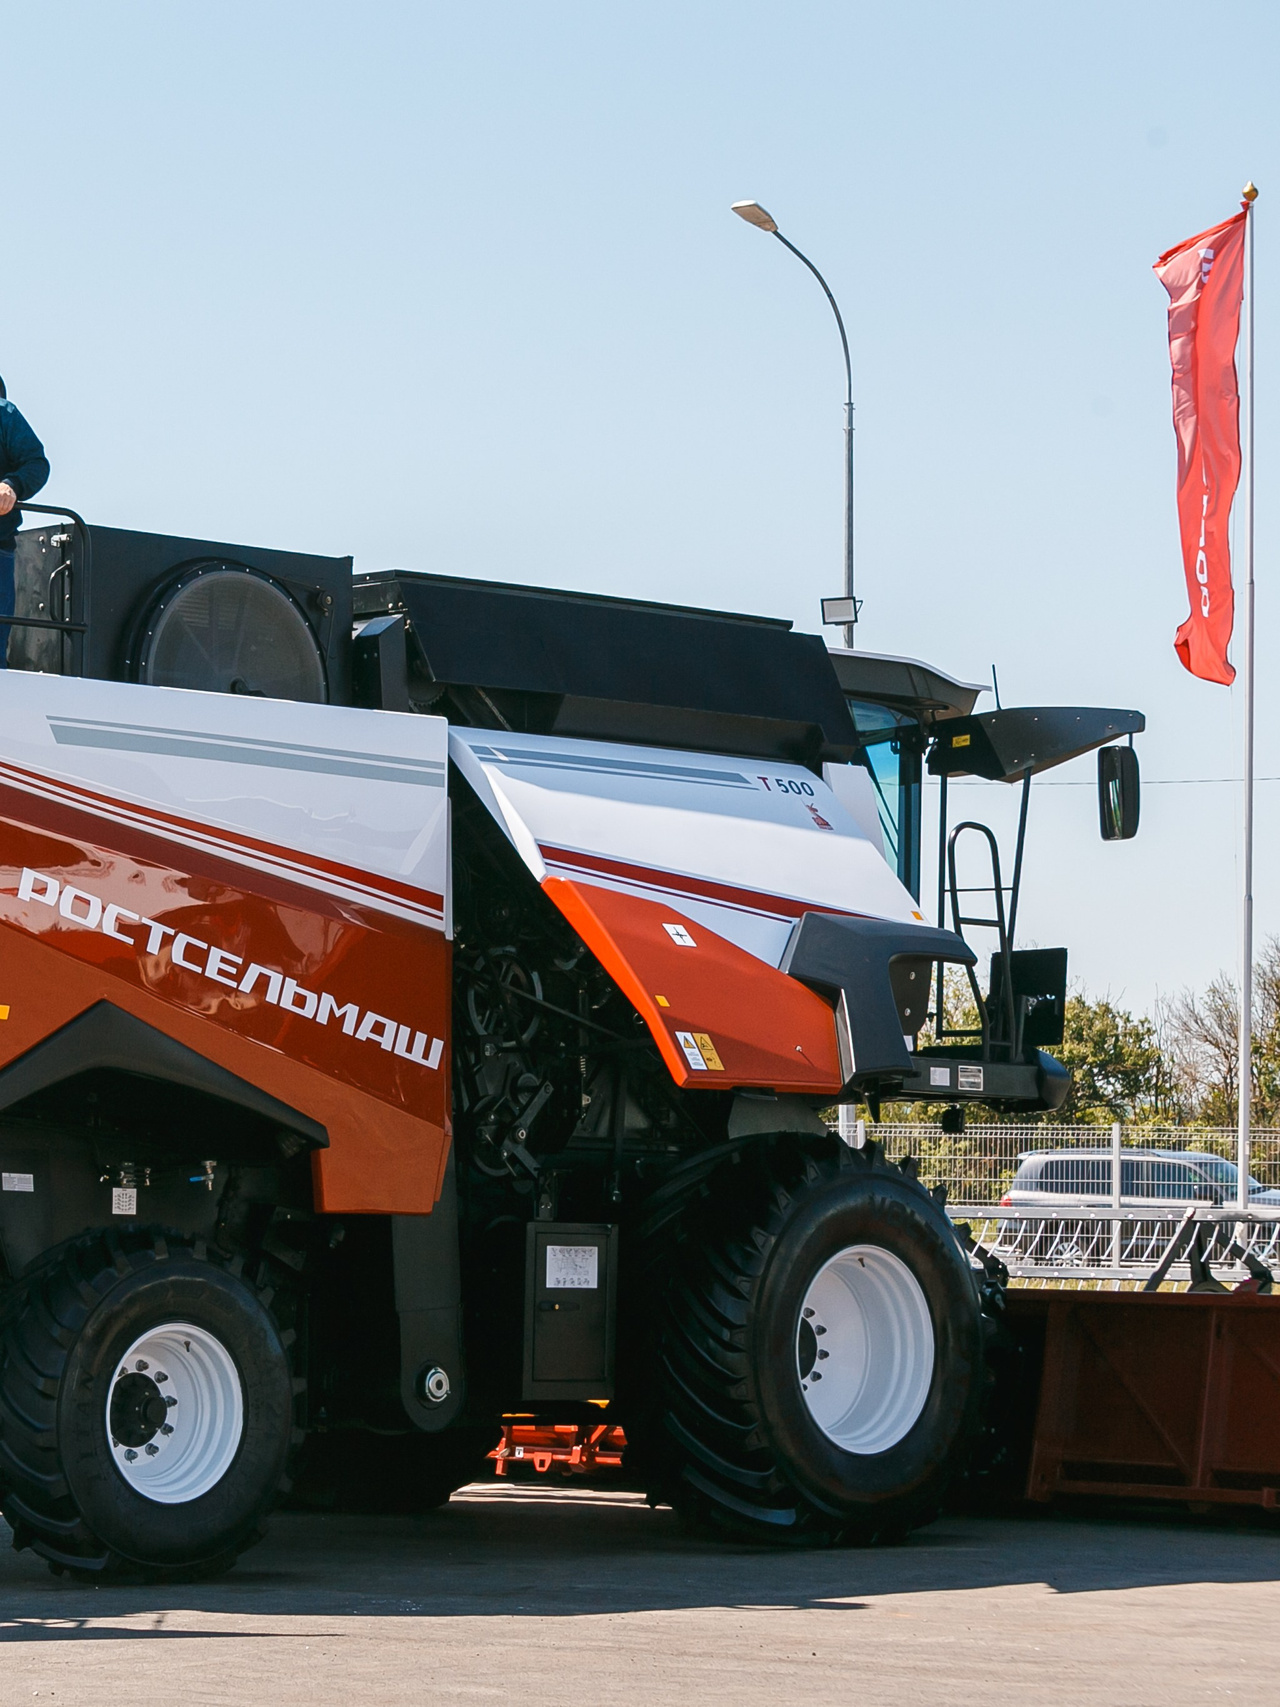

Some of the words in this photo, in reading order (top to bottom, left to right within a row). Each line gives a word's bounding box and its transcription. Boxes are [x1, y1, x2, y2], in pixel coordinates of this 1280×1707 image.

[757, 776, 772, 791] T
[775, 778, 815, 797] 500
[17, 866, 445, 1070] РОСТСЕЛЬМАШ
